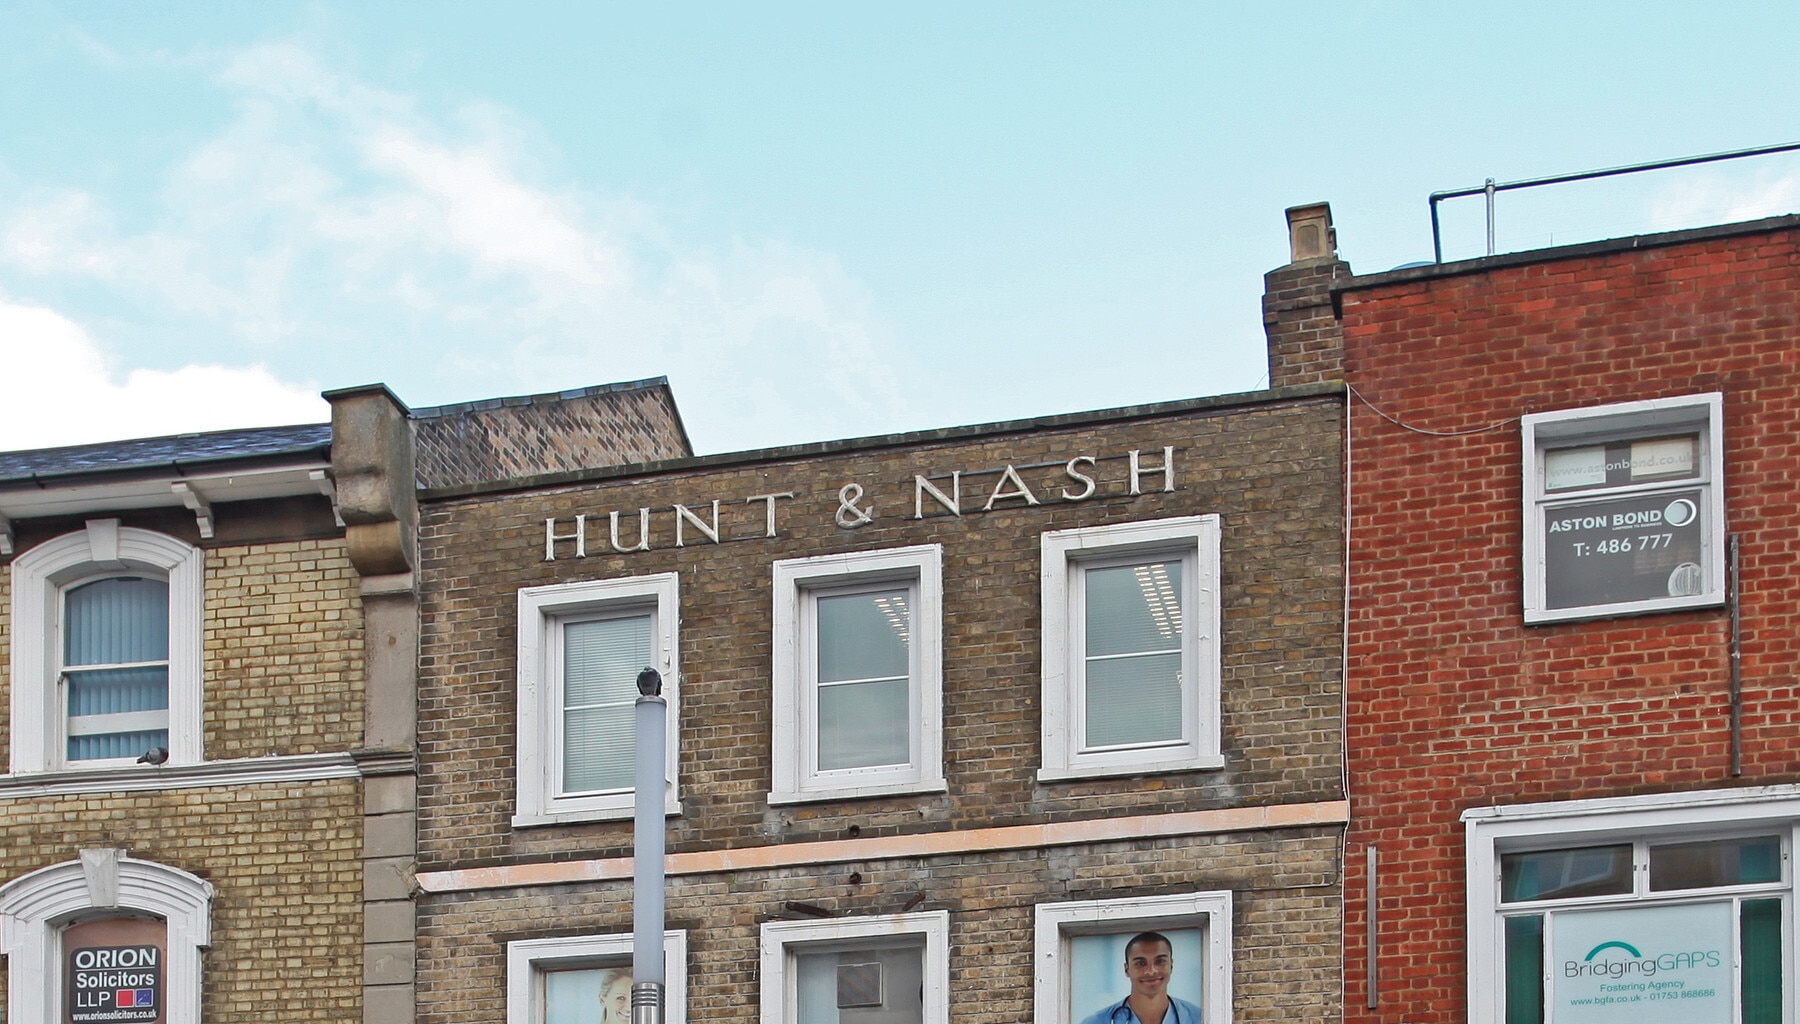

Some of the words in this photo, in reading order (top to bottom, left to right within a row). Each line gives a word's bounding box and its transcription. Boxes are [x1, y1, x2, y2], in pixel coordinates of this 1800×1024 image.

[1551, 452, 1694, 477] www.astonbond.co.uk
[545, 491, 795, 561] HUNT
[836, 483, 874, 530] &
[914, 446, 1176, 519] NASH
[1549, 515, 1607, 533] ASTON
[1612, 510, 1662, 526] BOND
[1573, 542, 1590, 557] T:
[1597, 538, 1632, 555] 486
[1638, 533, 1673, 551] 777
[75, 948, 156, 969] ORION
[1564, 951, 1720, 980] BridgingGAPS
[76, 972, 154, 988] Solicitors
[1600, 982, 1645, 993] Fostering
[1648, 980, 1685, 990] Agency
[77, 991, 110, 1007] LLP
[1570, 994, 1641, 1006] www.bgfa.co.uk
[1650, 991, 1678, 1000] 01753
[1681, 989, 1716, 999] 868686
[72, 1009, 157, 1022] www.orionsolicitors.co.uk
